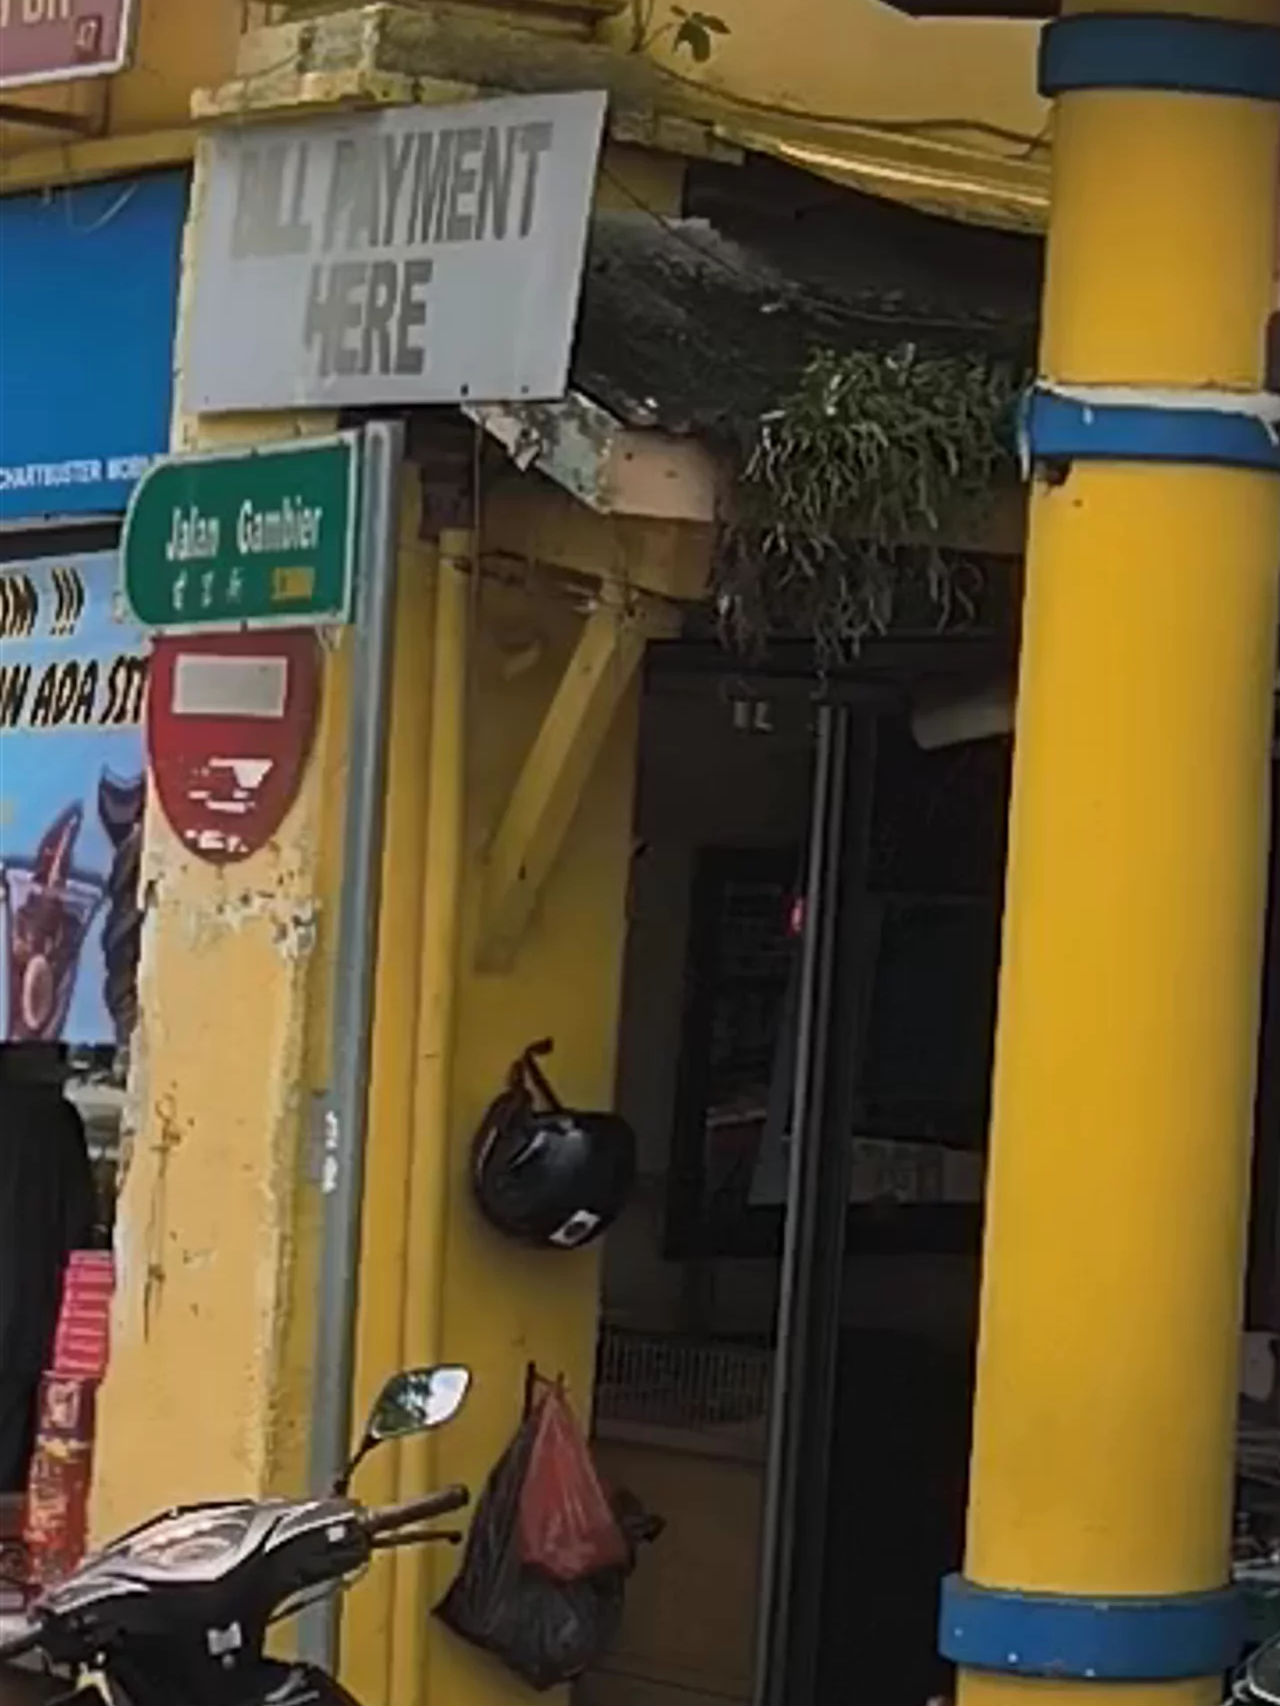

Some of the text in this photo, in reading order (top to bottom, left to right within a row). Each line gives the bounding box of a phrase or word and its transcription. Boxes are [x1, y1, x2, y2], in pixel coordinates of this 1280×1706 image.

[322, 120, 554, 253] PAYMENT
[304, 258, 434, 378] HERE
[166, 494, 323, 562] Jalan Gambier
[30, 658, 99, 727] ADA
